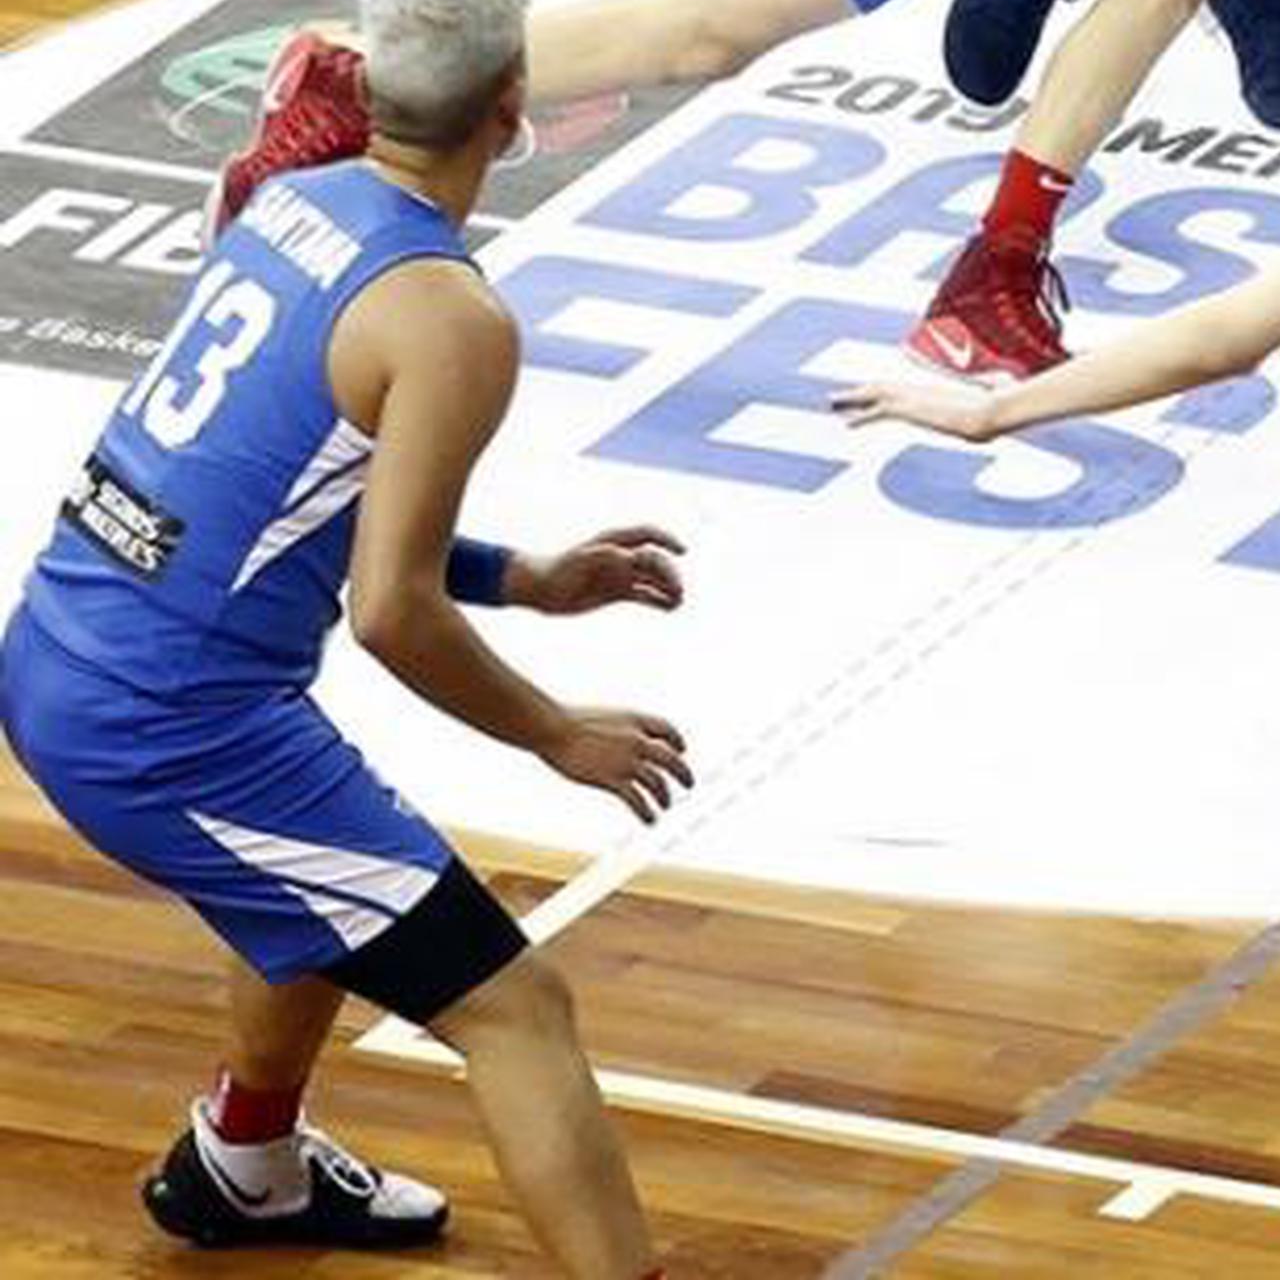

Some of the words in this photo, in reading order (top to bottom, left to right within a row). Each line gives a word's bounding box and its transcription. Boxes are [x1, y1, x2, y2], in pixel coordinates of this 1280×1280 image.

[0, 186, 206, 276] FIB
[24, 317, 168, 360] Baske
[121, 258, 277, 452] 13
